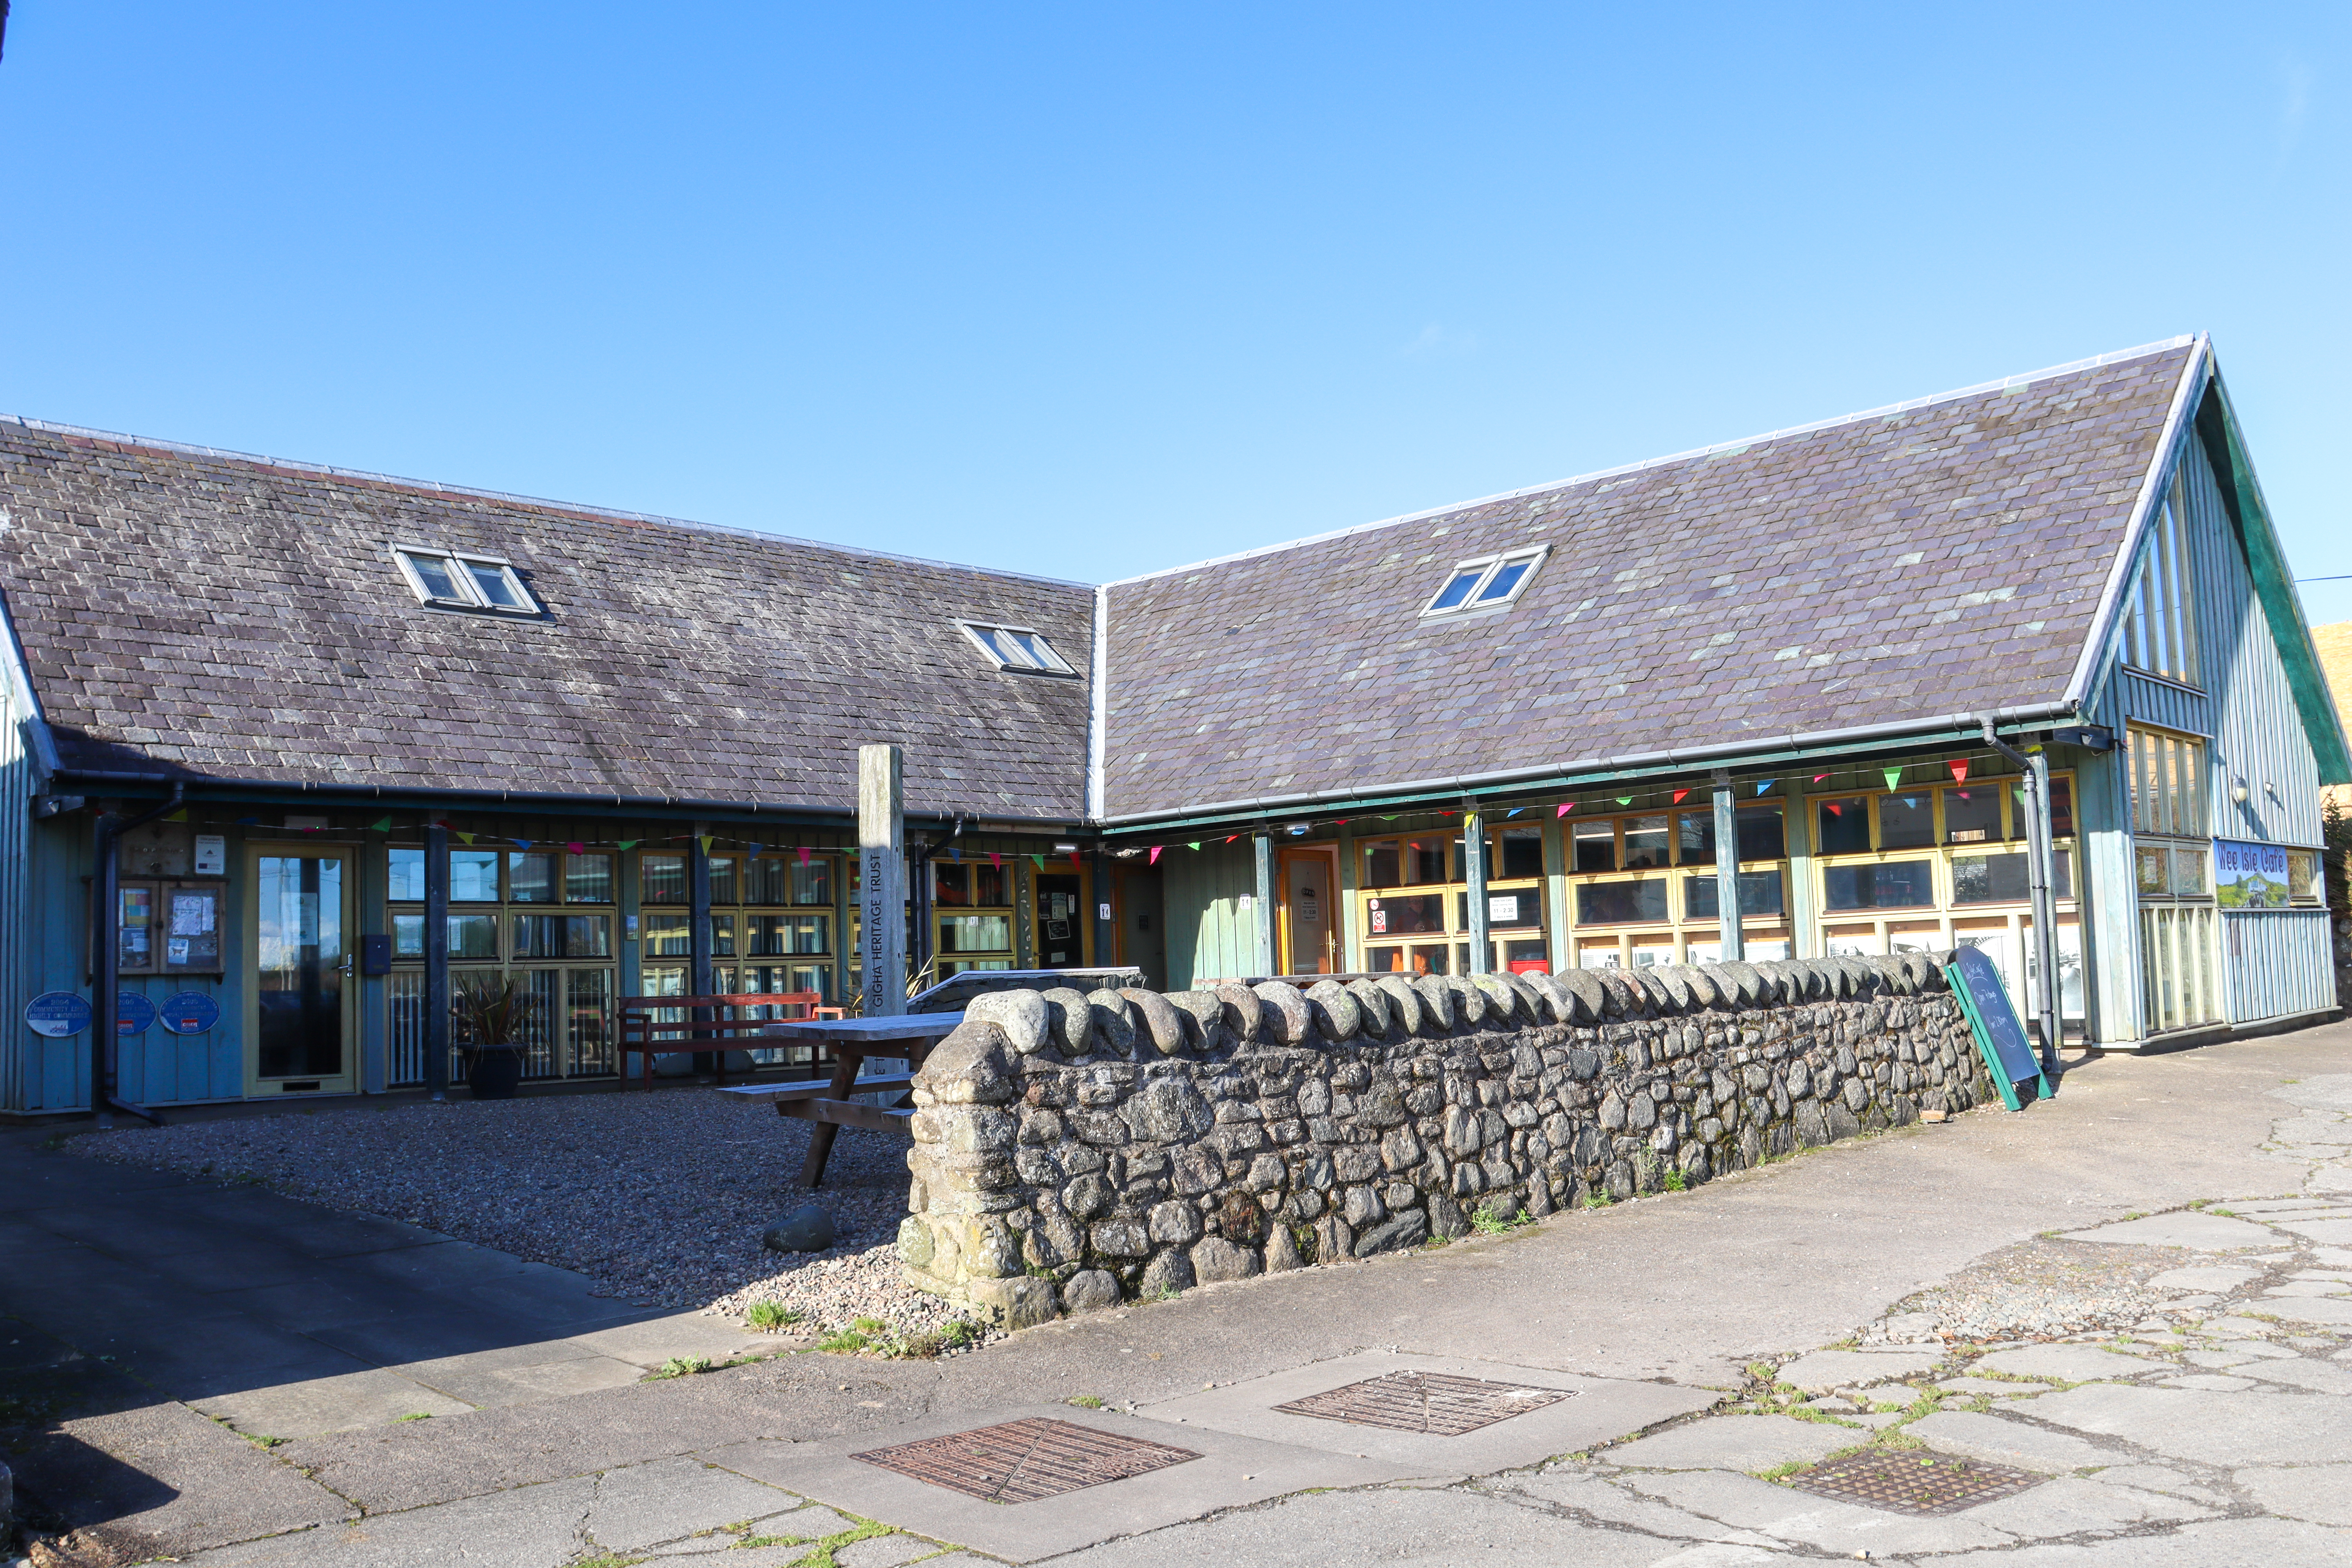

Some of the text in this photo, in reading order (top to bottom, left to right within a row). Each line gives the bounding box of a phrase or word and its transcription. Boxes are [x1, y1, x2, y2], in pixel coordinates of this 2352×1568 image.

[2217, 844, 2284, 873] Wee Isle Café
[871, 855, 883, 1007] GIGHA HERITAGE TRUST
[1974, 989, 1997, 1006] Open 7 days
